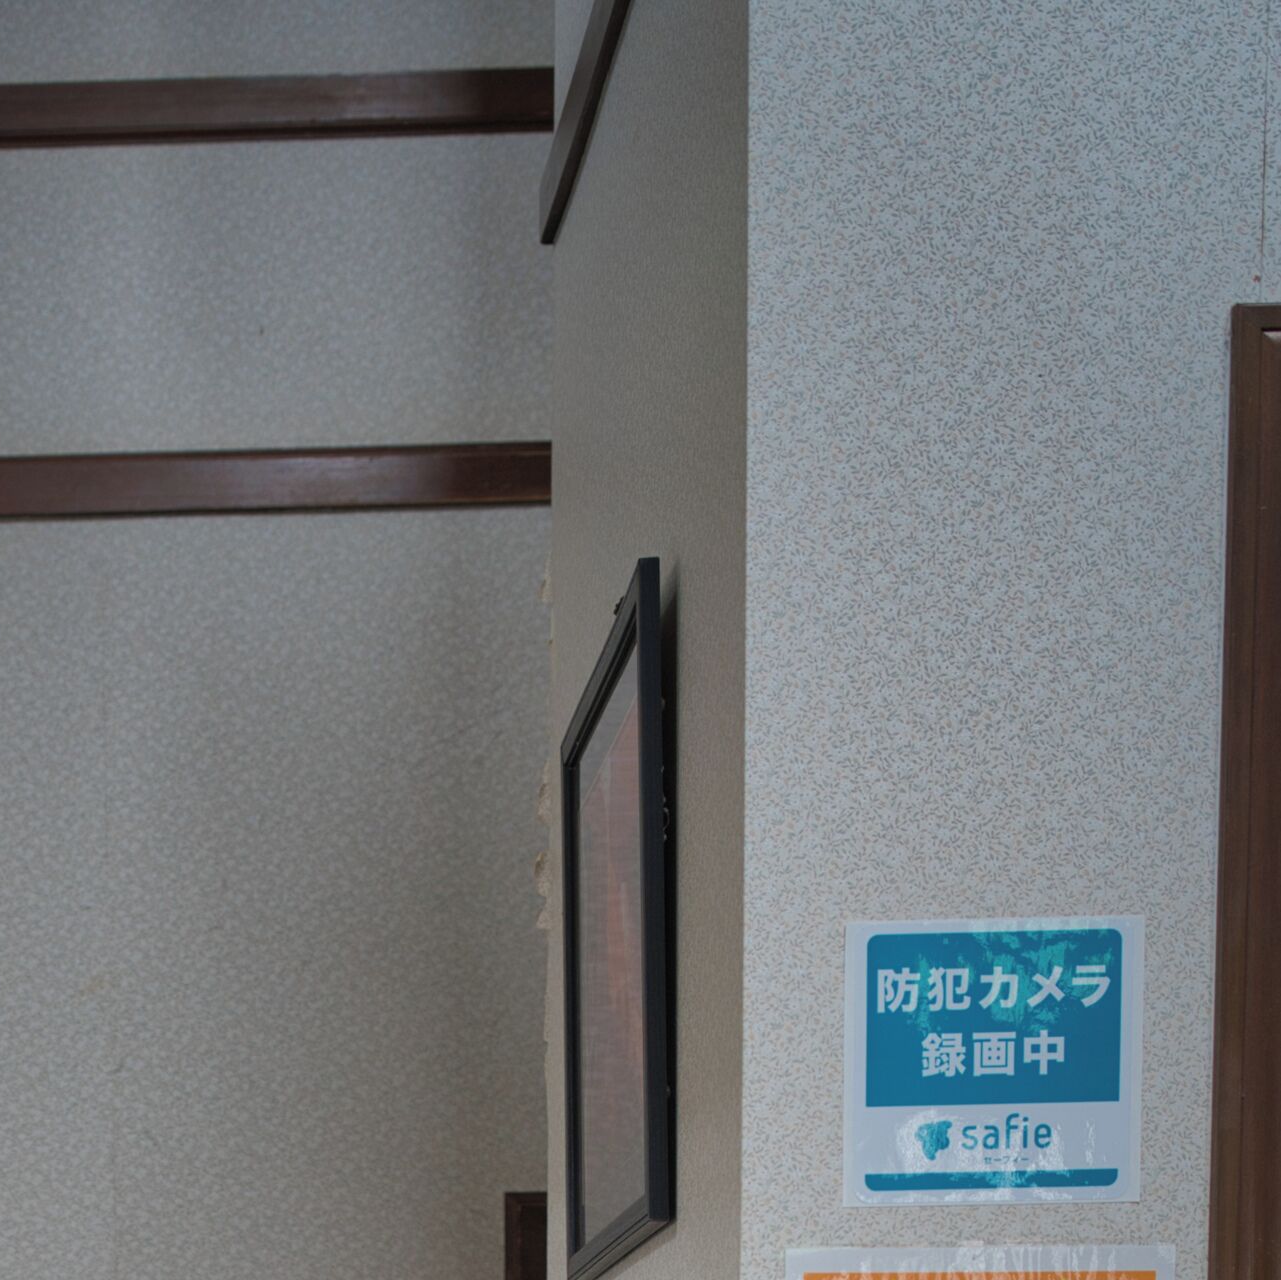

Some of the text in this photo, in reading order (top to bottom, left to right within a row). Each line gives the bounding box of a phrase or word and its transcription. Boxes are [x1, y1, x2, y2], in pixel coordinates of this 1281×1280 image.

[877, 965, 1111, 1013] 防犯カメラ
[921, 1030, 1065, 1077] 録画中
[961, 1112, 1052, 1150] safie
[984, 1155, 1029, 1165] セーフィー
